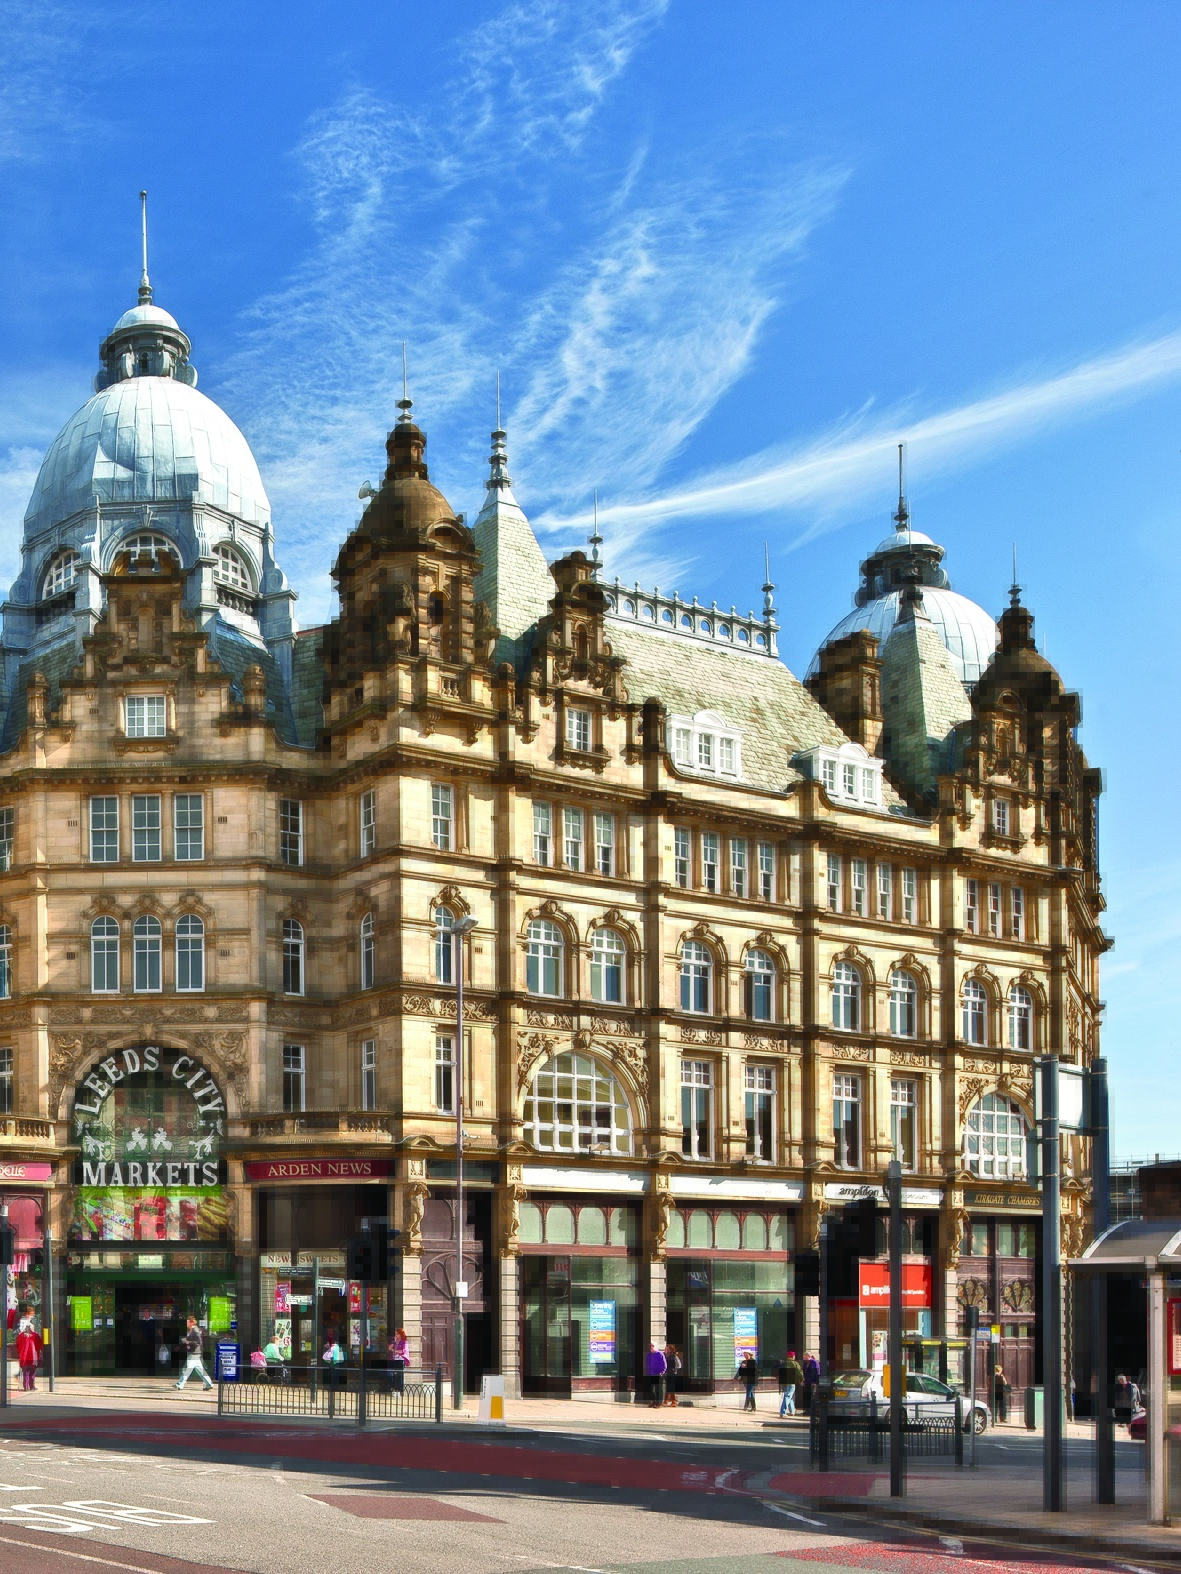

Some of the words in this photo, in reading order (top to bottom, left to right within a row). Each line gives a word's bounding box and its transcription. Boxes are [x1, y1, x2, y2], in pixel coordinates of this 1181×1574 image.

[74, 1046, 160, 1115] LEEDS
[171, 1055, 225, 1114] CITY
[81, 1161, 219, 1187] MARKETS
[268, 1163, 321, 1176] ARDEN
[327, 1162, 372, 1175] NEWS
[838, 1184, 879, 1198] amplifon
[974, 1193, 1005, 1204] KIRKGATE
[1007, 1194, 1041, 1206] CHAMBERS
